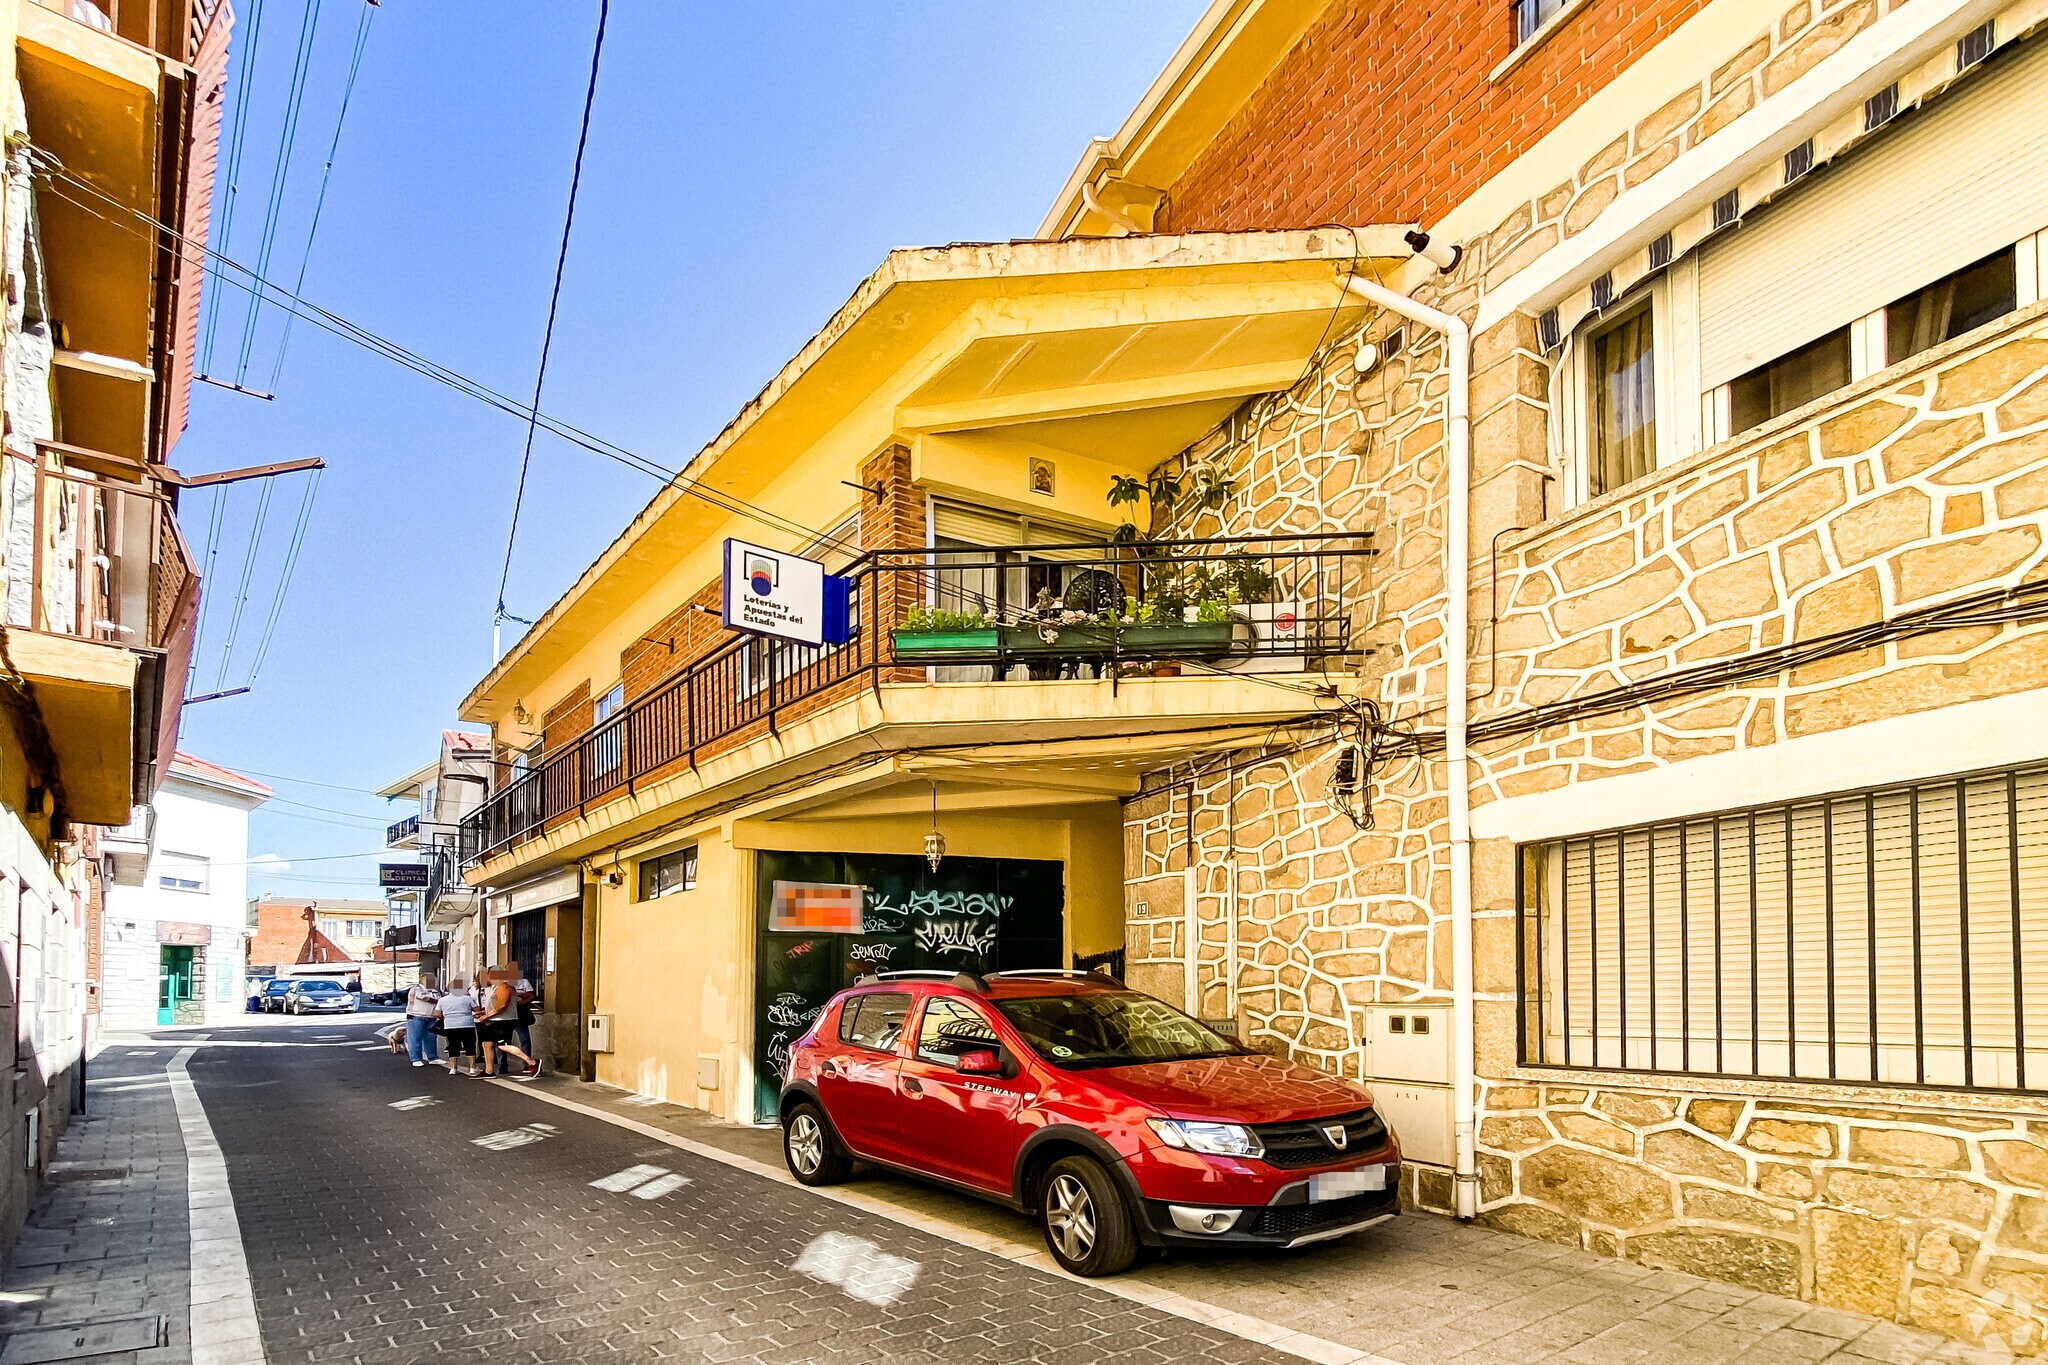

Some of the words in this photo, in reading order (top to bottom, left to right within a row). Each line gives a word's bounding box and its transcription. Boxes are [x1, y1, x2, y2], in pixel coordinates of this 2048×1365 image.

[744, 605, 787, 620] Apuestas
[789, 615, 803, 624] del
[783, 605, 789, 613] y
[743, 614, 775, 626] Estado
[963, 1081, 1016, 1099] STEPWAY
